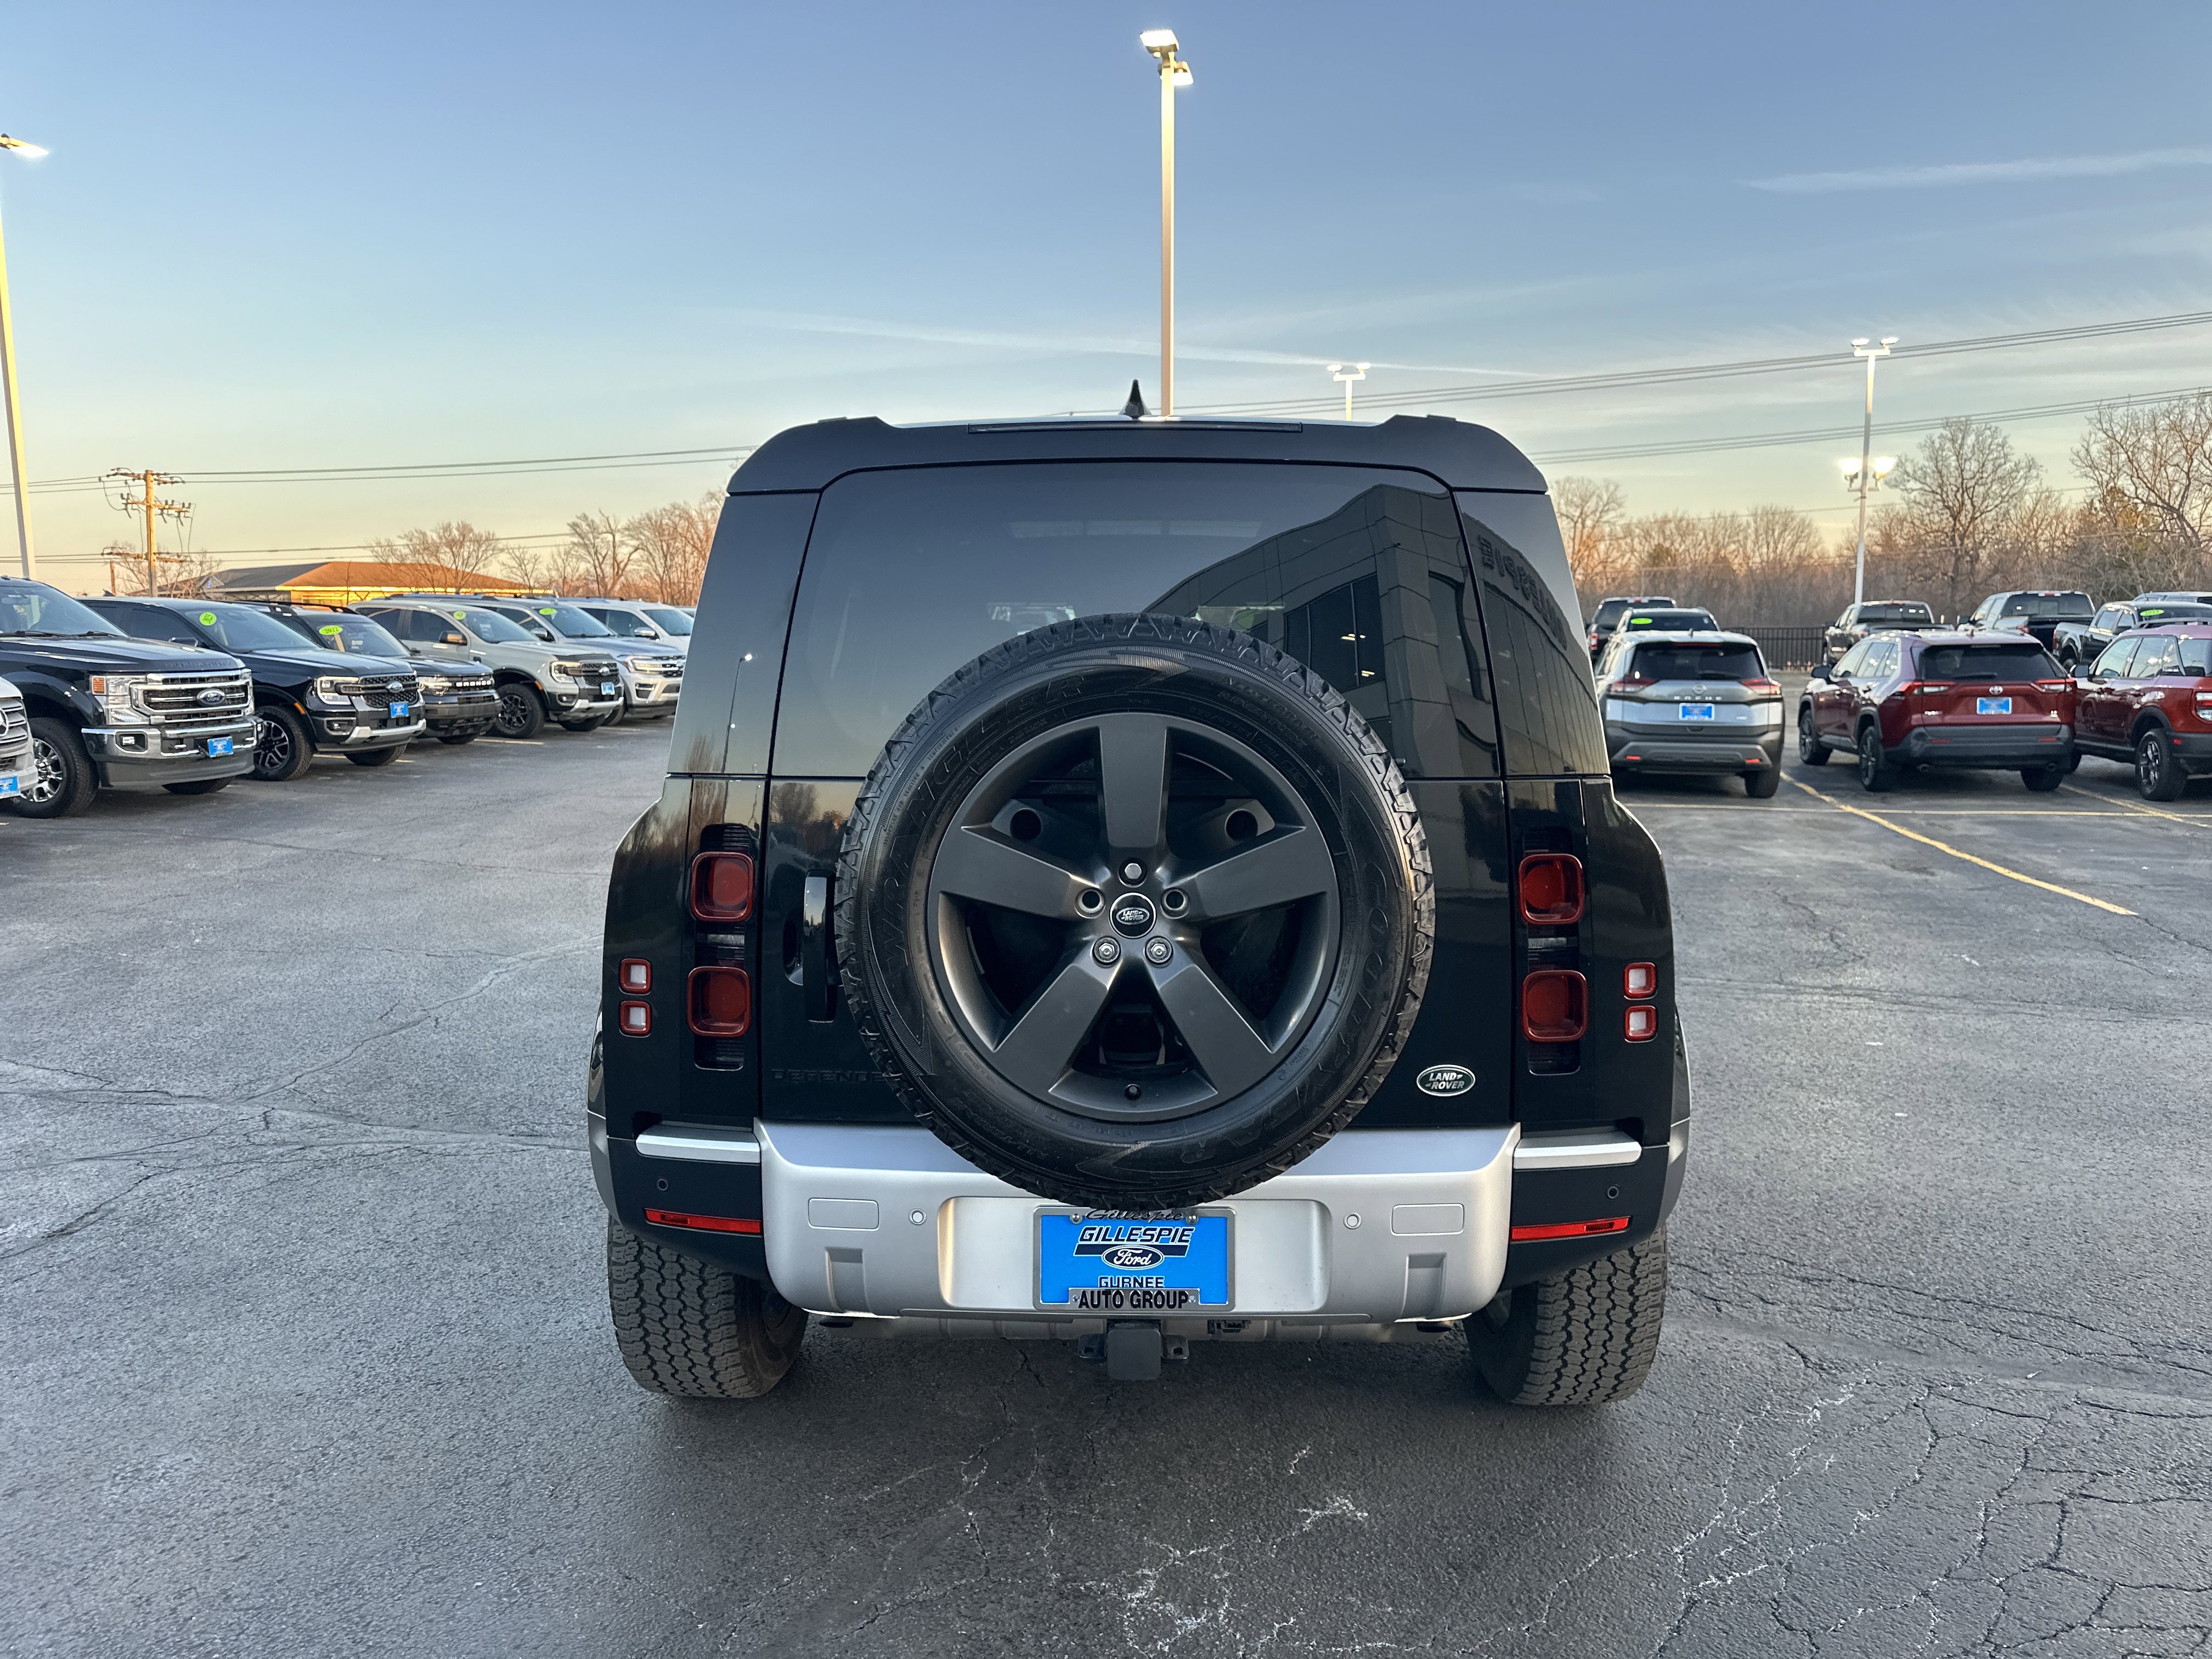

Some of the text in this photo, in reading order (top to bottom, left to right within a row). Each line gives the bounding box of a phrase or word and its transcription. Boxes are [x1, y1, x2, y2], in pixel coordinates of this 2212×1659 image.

[881, 670, 1087, 978] WRANGLER
[1178, 860, 1389, 1169] GOODYEAR
[771, 1069, 884, 1084] DEFENDE
[1429, 1072, 1457, 1081] LAND
[1431, 1080, 1465, 1090] ROVER
[1085, 1209, 1184, 1223] Gillespie
[1077, 1226, 1196, 1244] GILLESPIE
[1113, 1248, 1152, 1266] Ford
[1098, 1276, 1165, 1288] GURNEE
[1078, 1289, 1189, 1310] AUTO GROUP
